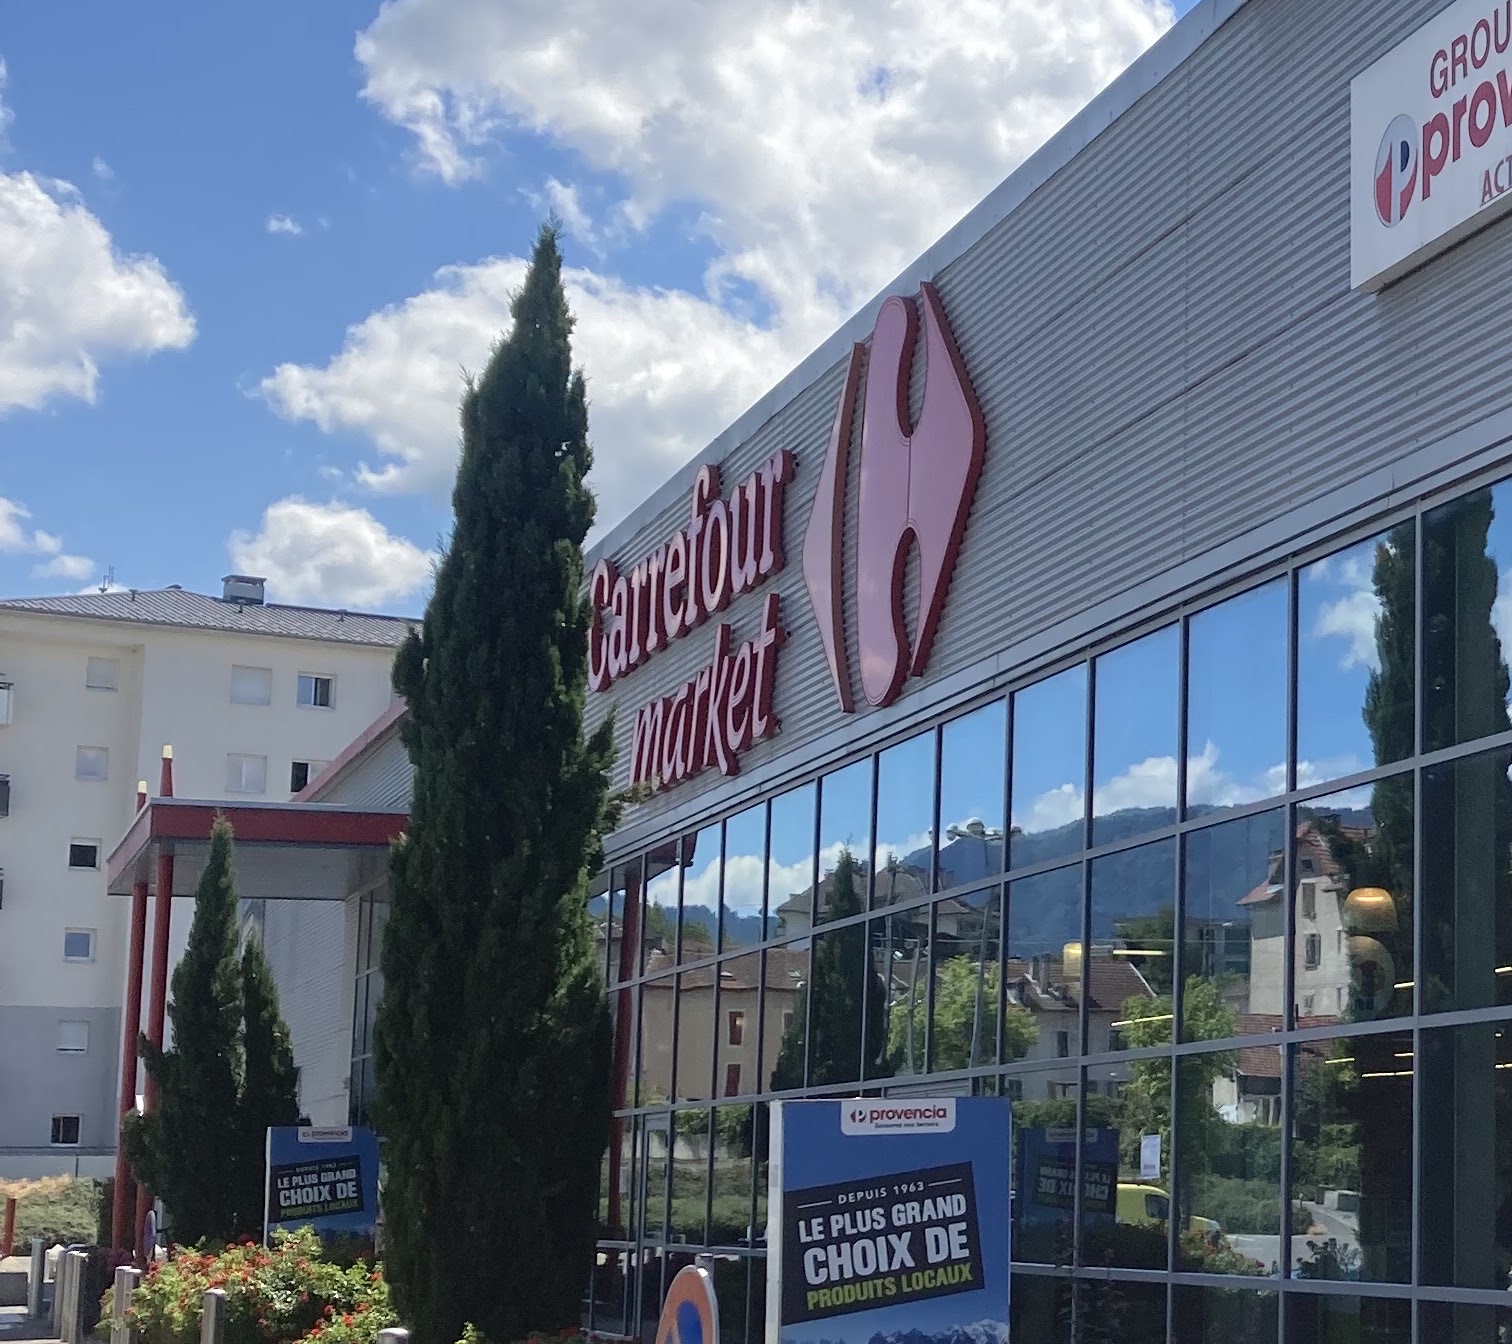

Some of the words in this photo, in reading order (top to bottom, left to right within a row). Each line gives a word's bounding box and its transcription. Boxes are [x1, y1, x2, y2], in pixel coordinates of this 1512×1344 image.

[587, 448, 796, 693] Carrefour
[629, 593, 784, 790] market
[869, 1104, 948, 1125] provencia
[277, 1177, 290, 1189] LE
[291, 1173, 319, 1187] PLUS
[279, 1184, 332, 1207] CHOIX
[335, 1181, 358, 1199] DE
[837, 1187, 888, 1205] DEPUIS
[893, 1181, 926, 1196] 1963
[798, 1217, 826, 1244] LE
[829, 1207, 887, 1238] PLUS
[891, 1193, 967, 1227] GRAND
[803, 1230, 916, 1286] CHOIX
[925, 1221, 970, 1264] DE
[806, 1276, 898, 1311] PRODUITS
[900, 1262, 973, 1293] LOCAUX
